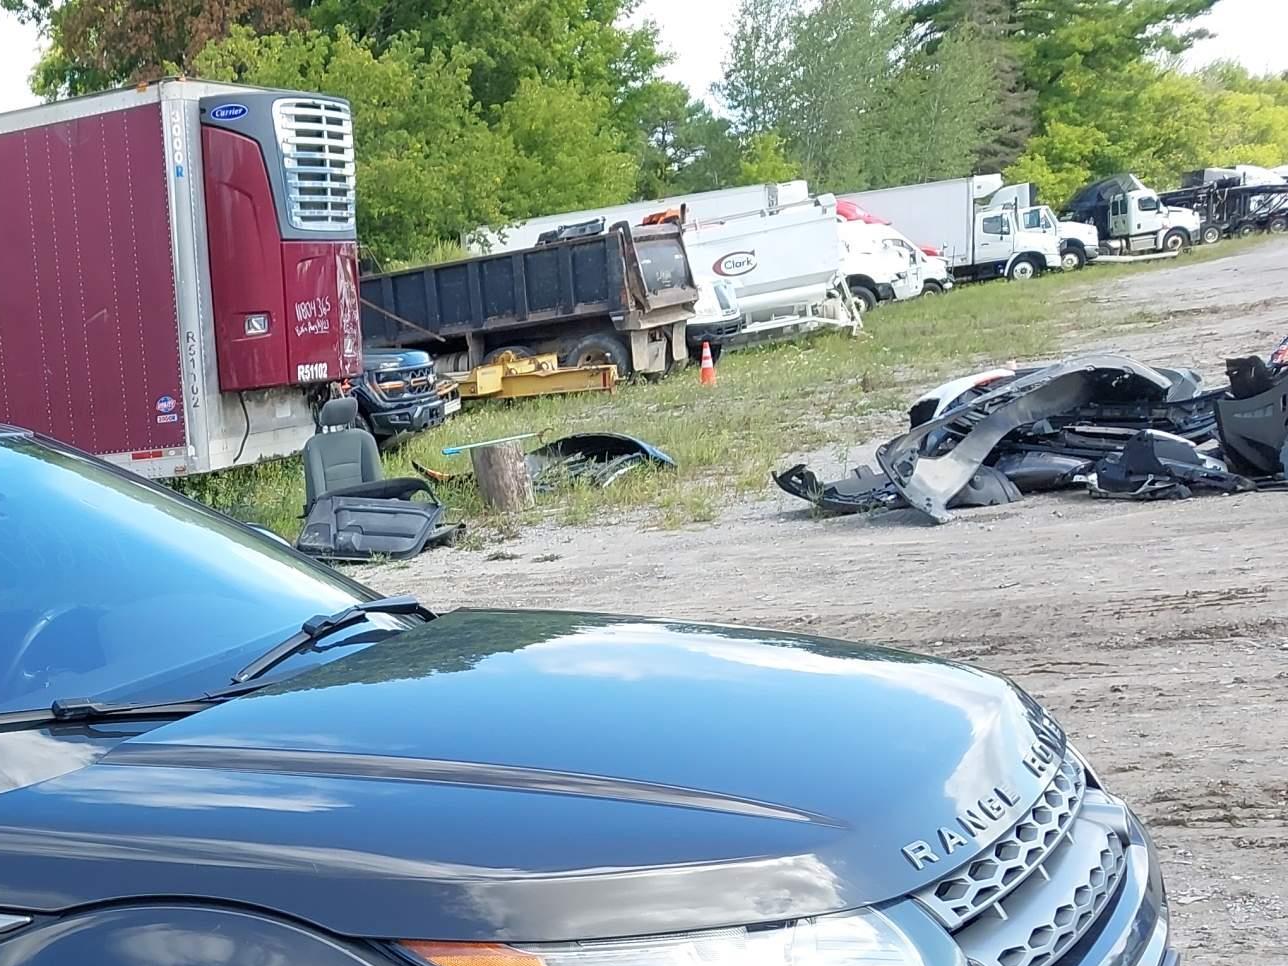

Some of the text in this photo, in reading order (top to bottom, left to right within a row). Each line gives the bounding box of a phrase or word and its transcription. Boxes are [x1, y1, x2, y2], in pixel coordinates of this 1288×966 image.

[215, 106, 244, 118] Carrier
[724, 257, 753, 270] Clark
[297, 362, 329, 382] R51102
[901, 787, 1021, 871] RANGE
